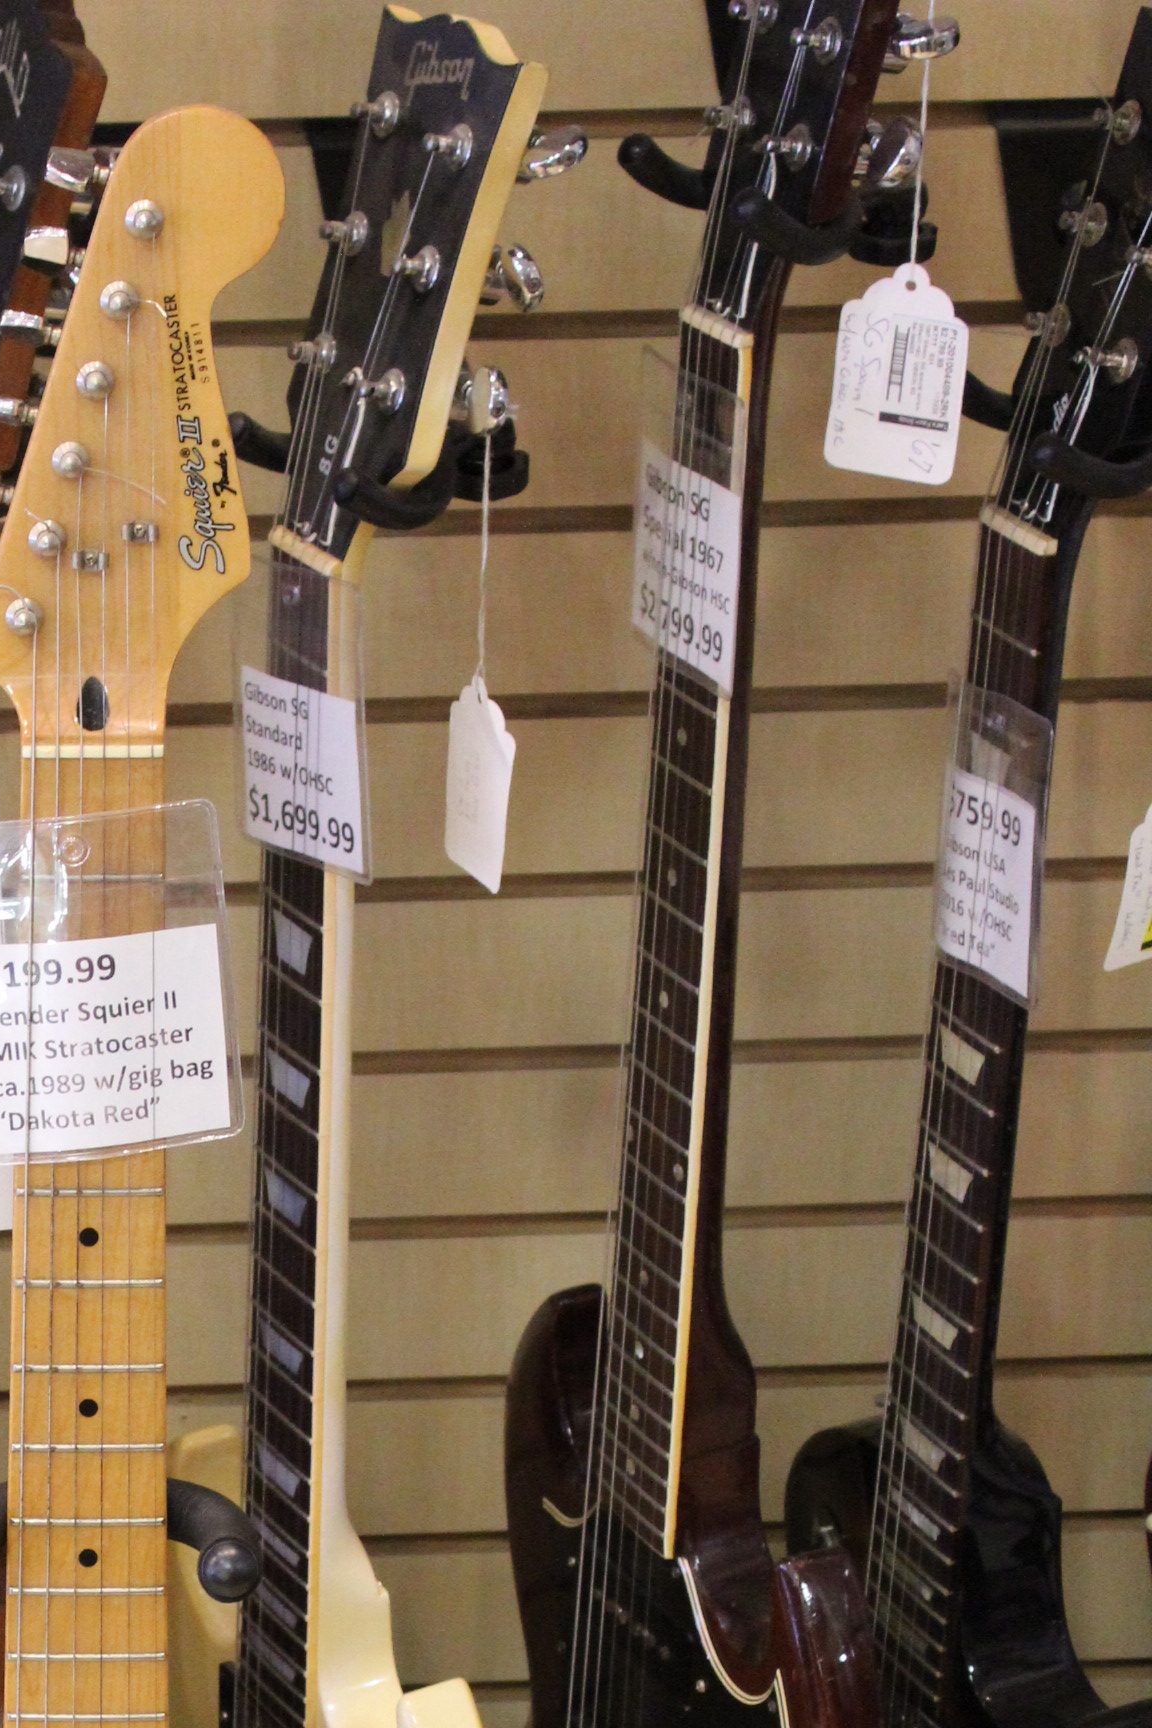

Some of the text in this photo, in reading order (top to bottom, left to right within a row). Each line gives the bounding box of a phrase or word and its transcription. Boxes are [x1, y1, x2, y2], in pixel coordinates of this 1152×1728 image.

[164, 294, 191, 411] STRATOCASTER
[213, 449, 237, 497] Fender
[176, 414, 235, 574] Squier II
[690, 491, 710, 521] SG
[689, 536, 723, 574] 1967
[244, 682, 309, 720] Gibson SG
[246, 715, 302, 750] Standard
[248, 748, 333, 796] 1986 w/OHSC
[249, 784, 355, 853] $1,699.99
[984, 851, 1007, 876] USA
[959, 870, 985, 896] Paul
[987, 882, 1020, 915] Studio
[78, 997, 155, 1024] Squier
[44, 1026, 194, 1059] Stratocaster
[94, 1065, 163, 1093] w/gig
[170, 1058, 214, 1081] bag
[104, 1096, 160, 1124] Red”
